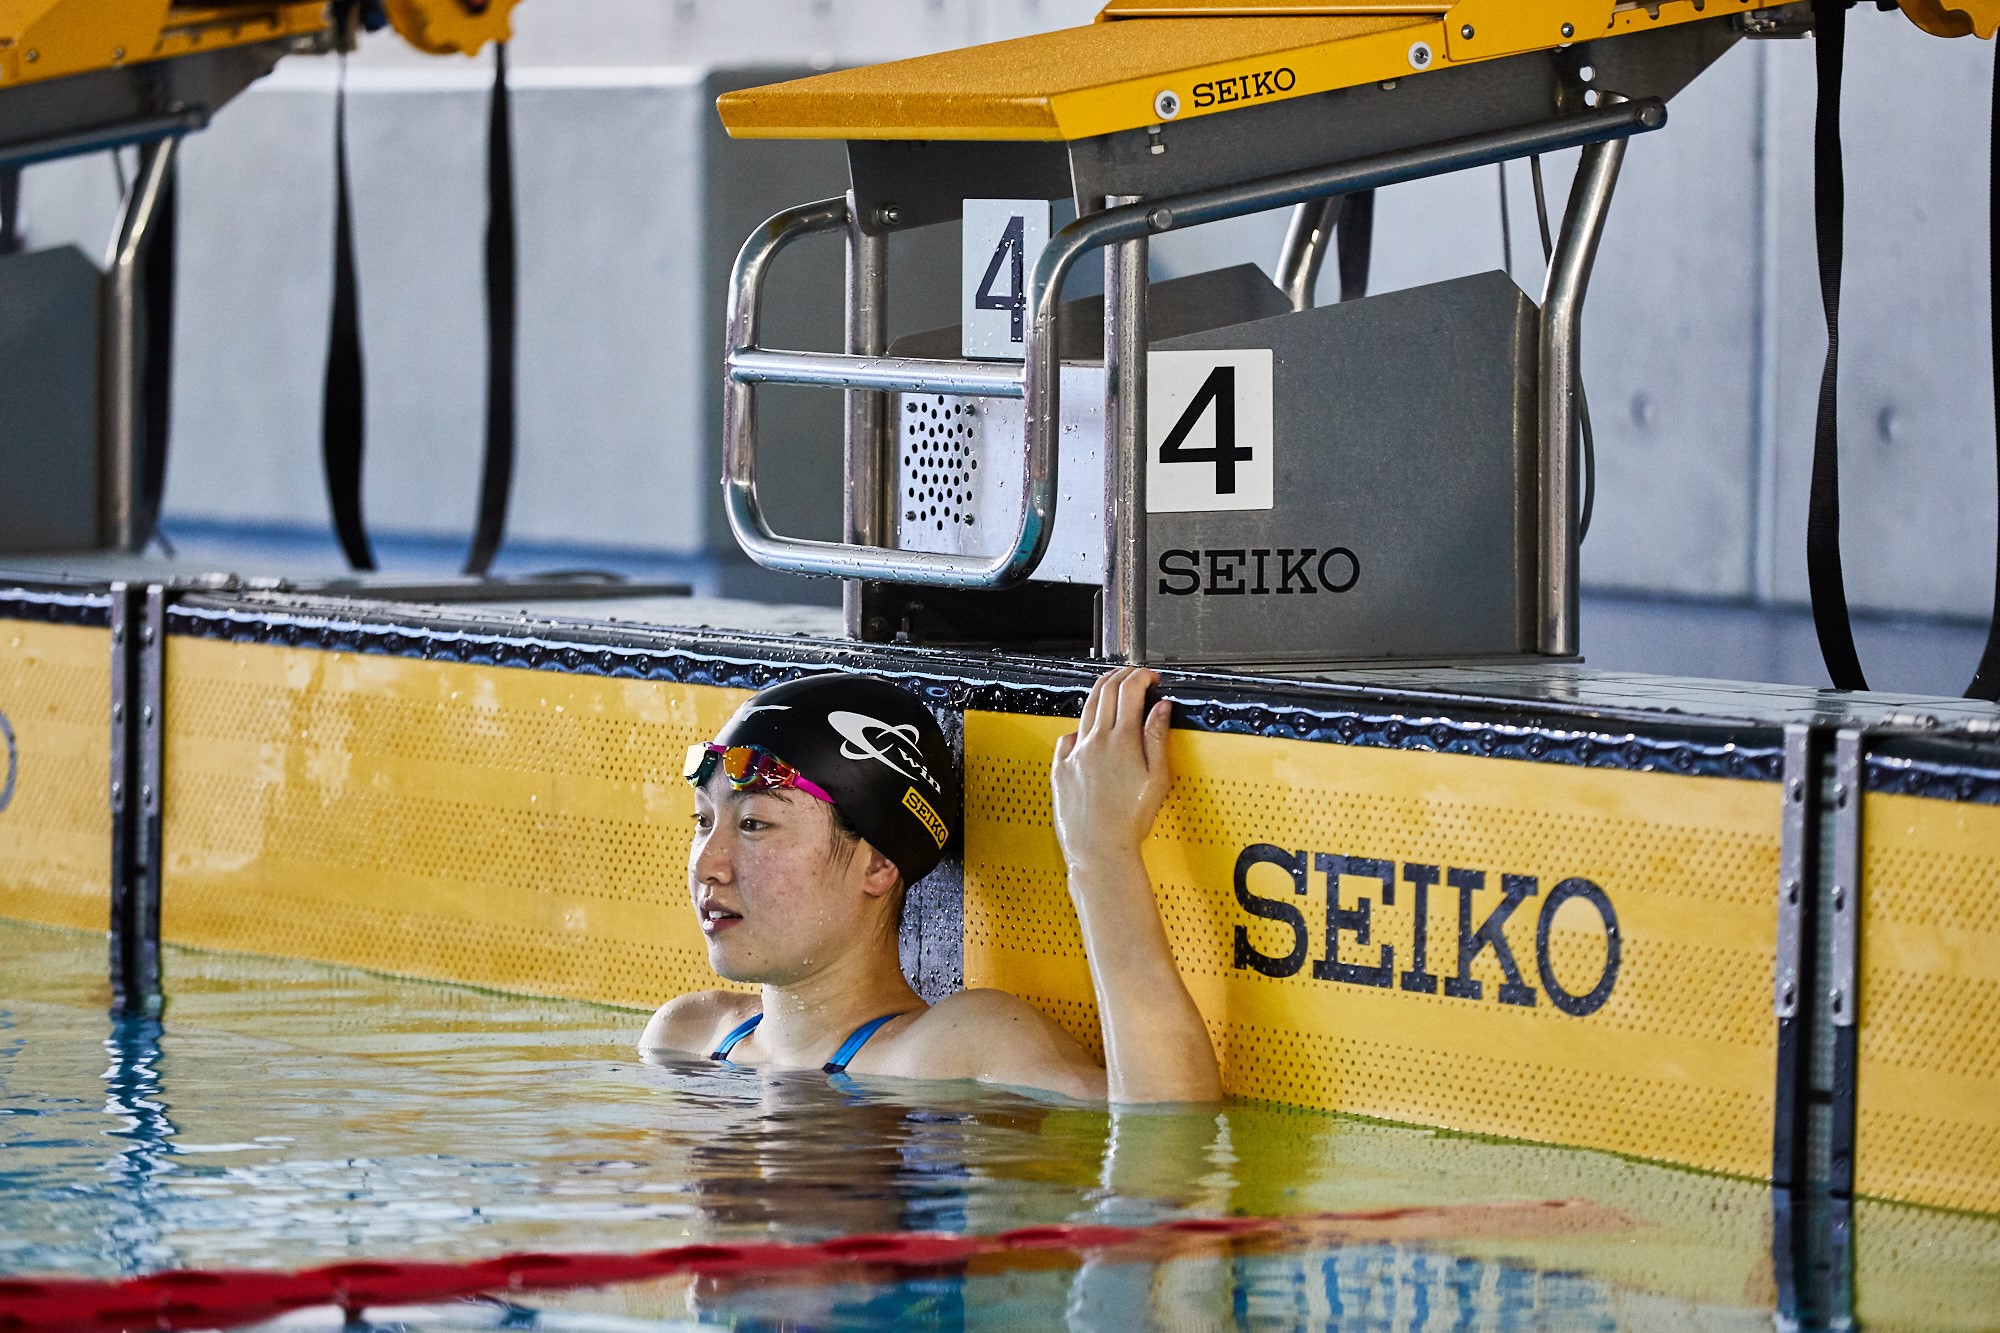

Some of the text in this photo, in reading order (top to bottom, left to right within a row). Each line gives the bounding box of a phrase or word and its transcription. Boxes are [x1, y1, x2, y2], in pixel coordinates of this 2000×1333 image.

[1193, 67, 1296, 108] SEIKO
[976, 216, 1026, 343] 4
[1159, 366, 1253, 494] 4
[1158, 548, 1361, 597] SEIKO
[906, 793, 948, 845] SEIKO
[1233, 843, 1620, 1017] SEIKO
